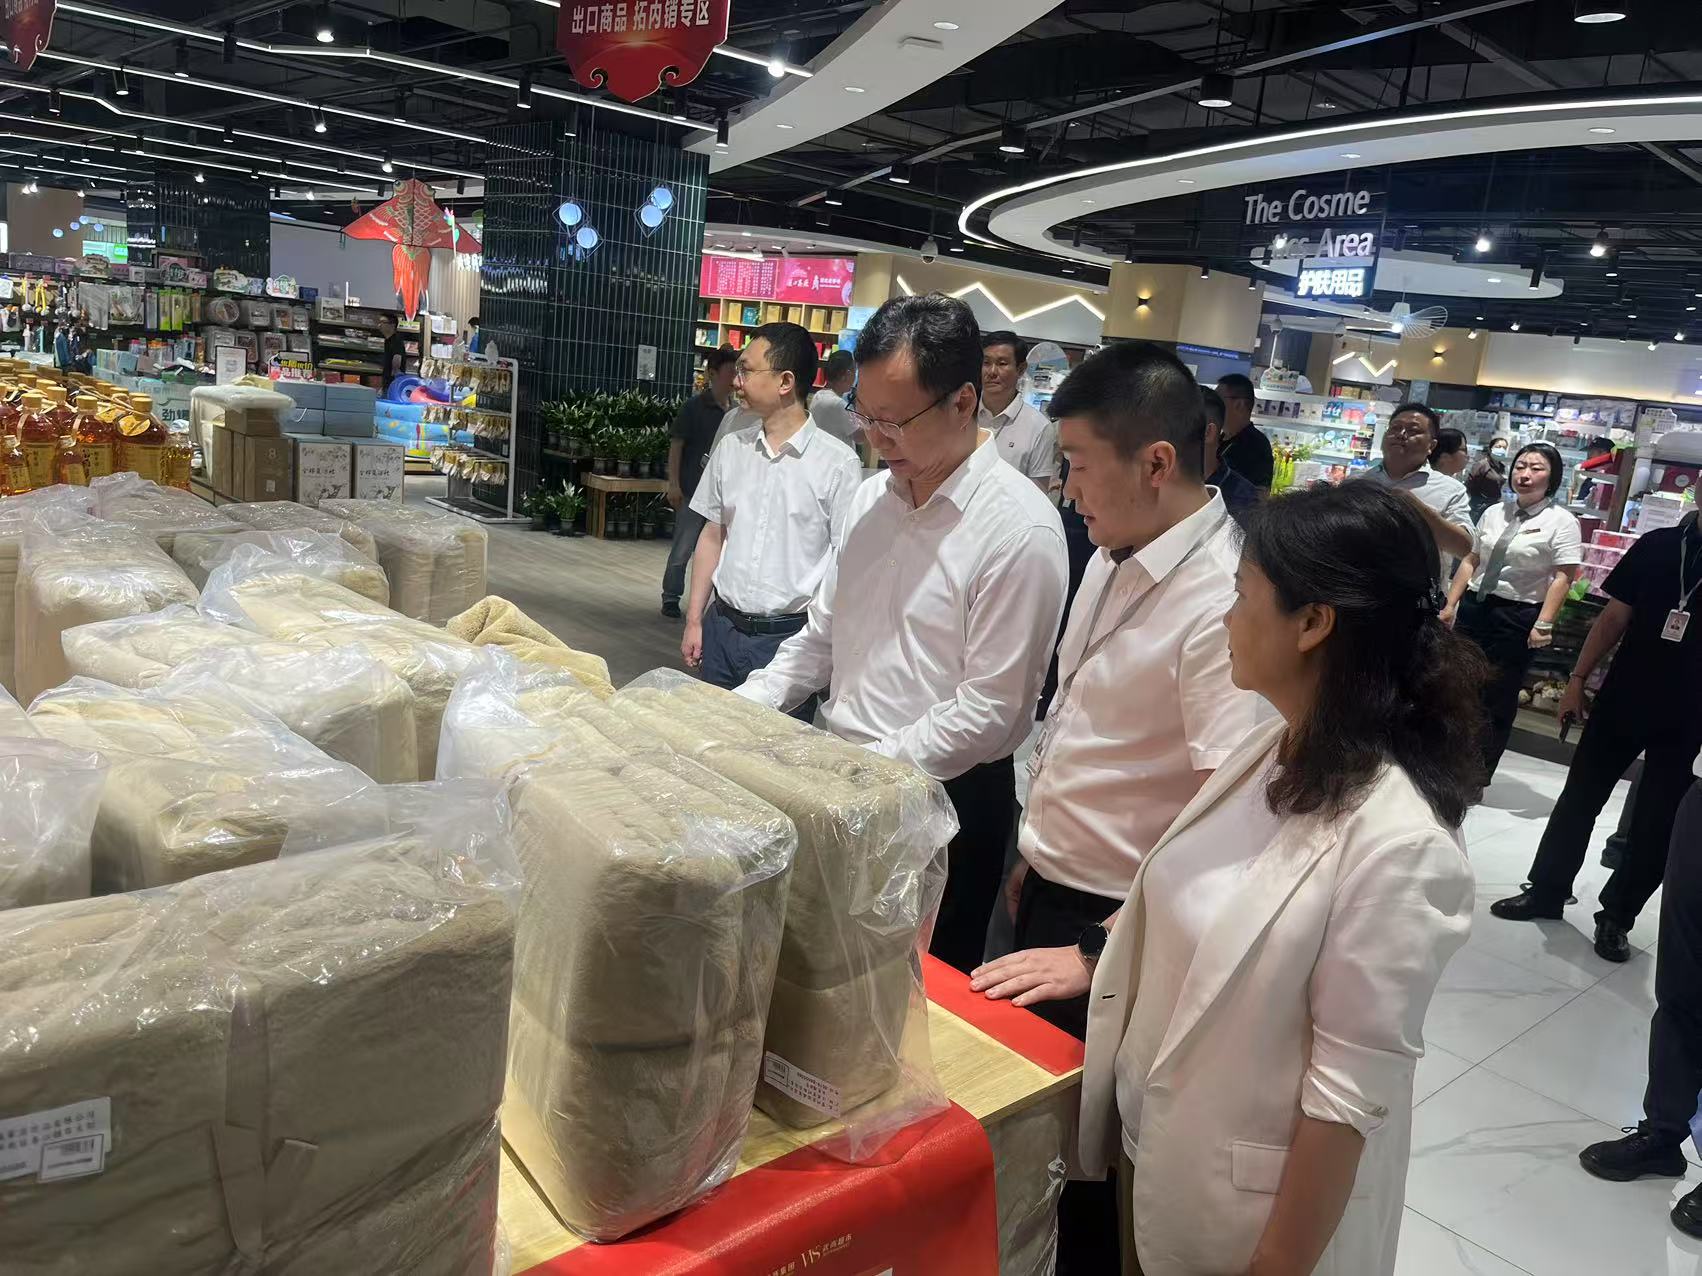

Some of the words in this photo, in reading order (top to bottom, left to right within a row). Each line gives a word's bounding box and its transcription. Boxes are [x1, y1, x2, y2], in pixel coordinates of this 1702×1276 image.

[572, 3, 627, 34] 出口商品
[633, 0, 711, 30] 拓内销专区
[1245, 193, 1282, 225] The
[1288, 189, 1370, 220] Cosme
[1315, 228, 1374, 258] Area
[1297, 268, 1366, 297] 护肤用品
